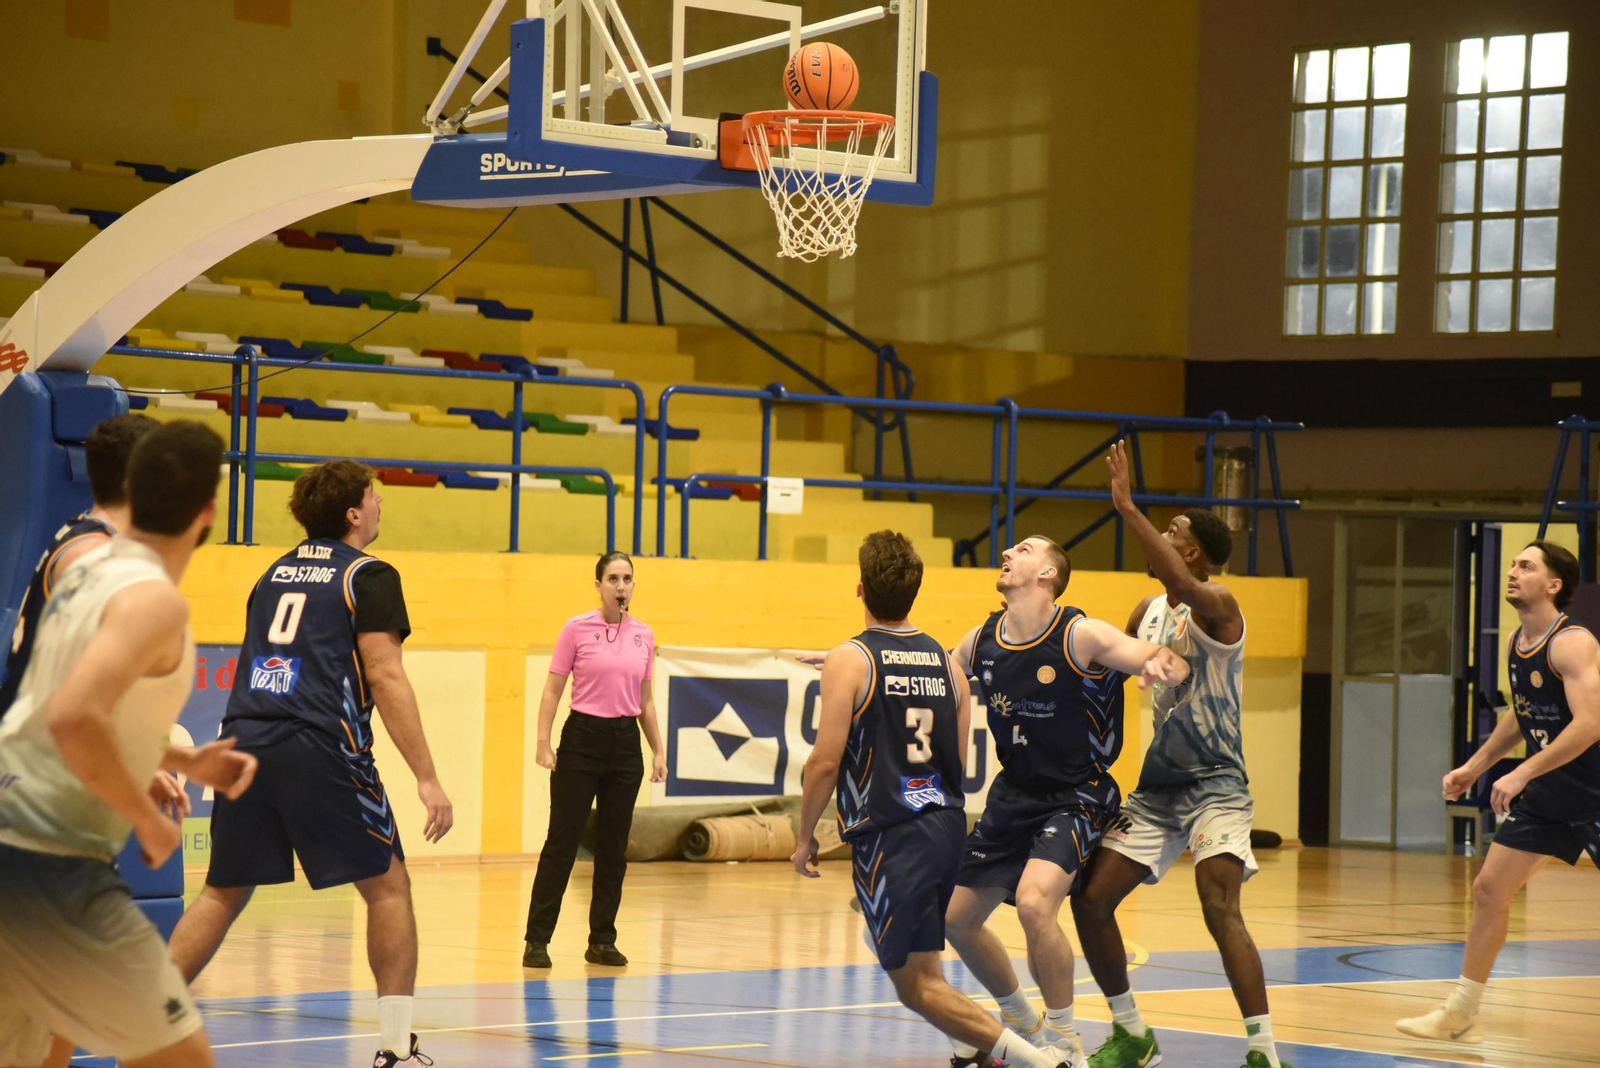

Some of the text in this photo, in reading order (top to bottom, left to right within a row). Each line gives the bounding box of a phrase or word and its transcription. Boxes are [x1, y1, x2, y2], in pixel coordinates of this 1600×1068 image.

[787, 50, 802, 97] Wilso
[294, 566, 337, 583] STROG
[268, 592, 307, 645] 0
[250, 667, 291, 694] UBAGO
[911, 676, 946, 697] STROG
[905, 707, 934, 764] 3
[1012, 724, 1028, 747] 4
